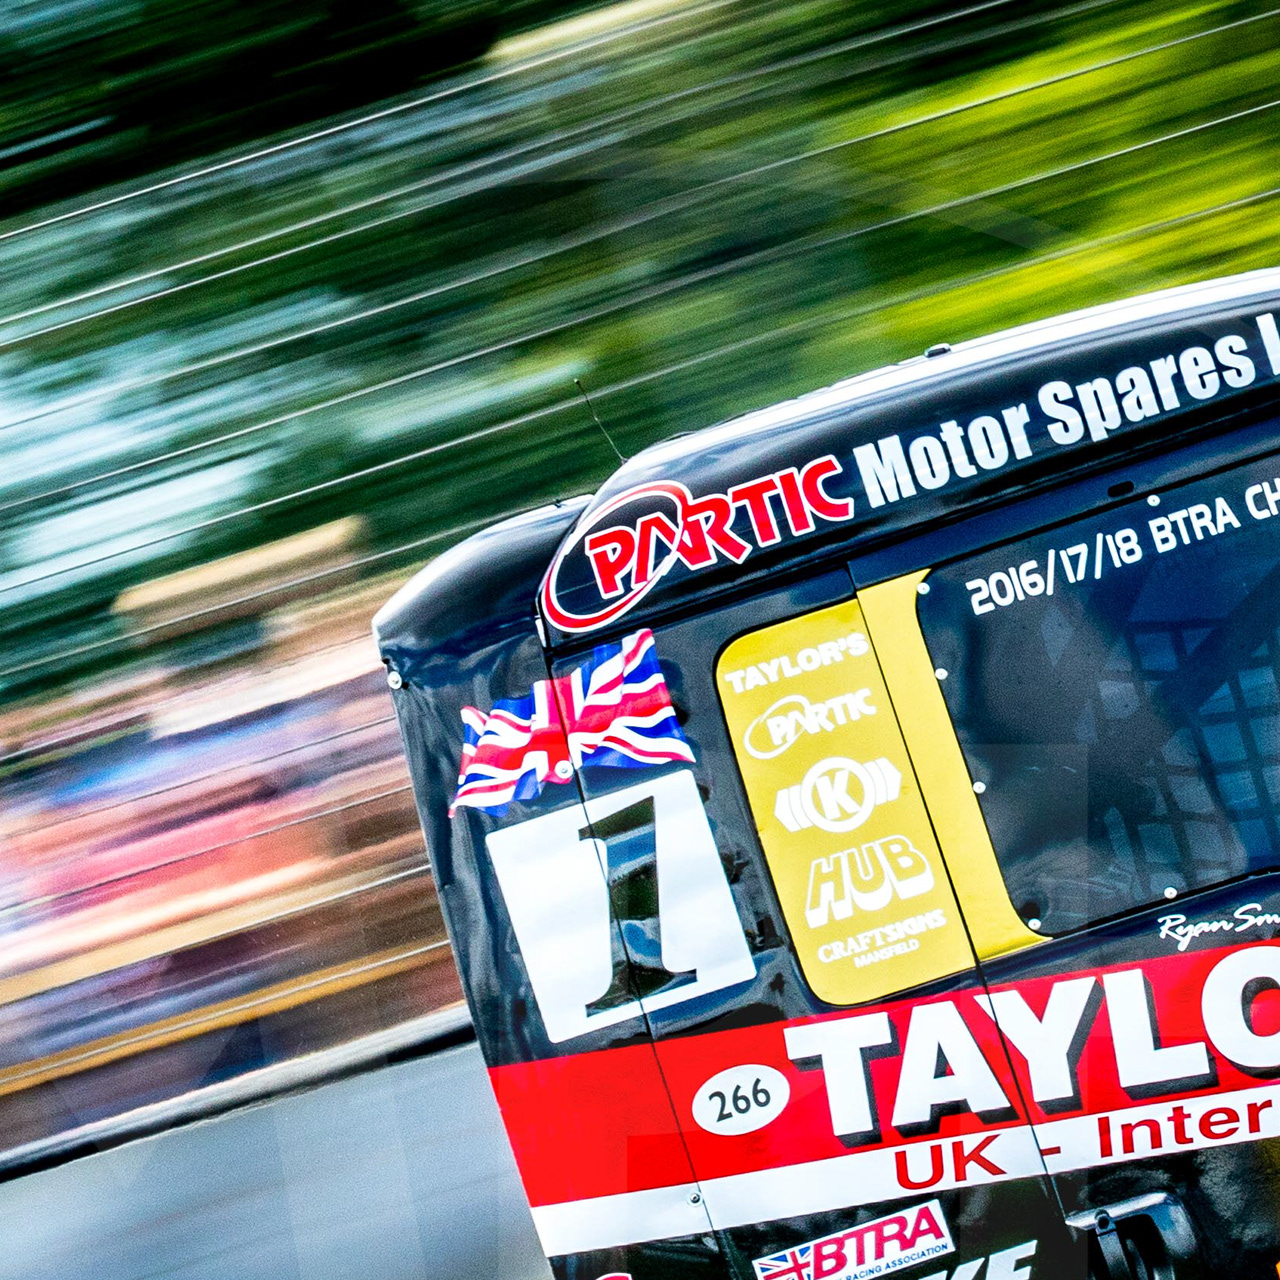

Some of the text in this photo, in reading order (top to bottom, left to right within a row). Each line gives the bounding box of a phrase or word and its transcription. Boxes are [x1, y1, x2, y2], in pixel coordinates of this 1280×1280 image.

[585, 455, 855, 598] PARTIC
[851, 402, 1032, 508] Motor
[1038, 334, 1256, 446] Spares
[965, 527, 1143, 615] 2016/17/18
[1148, 498, 1241, 556] BTRA
[724, 632, 870, 694] TAYLOR'S
[766, 688, 876, 746] PARTIC
[578, 795, 698, 1017] 1
[804, 834, 935, 929] HUB
[854, 938, 919, 968] MANSFIELD
[1157, 914, 1234, 951] Ryan
[708, 1078, 771, 1122] 266
[894, 1135, 1007, 1190] UK
[813, 1206, 945, 1280] BTRA
[885, 1243, 948, 1271] ASSOCIATION
